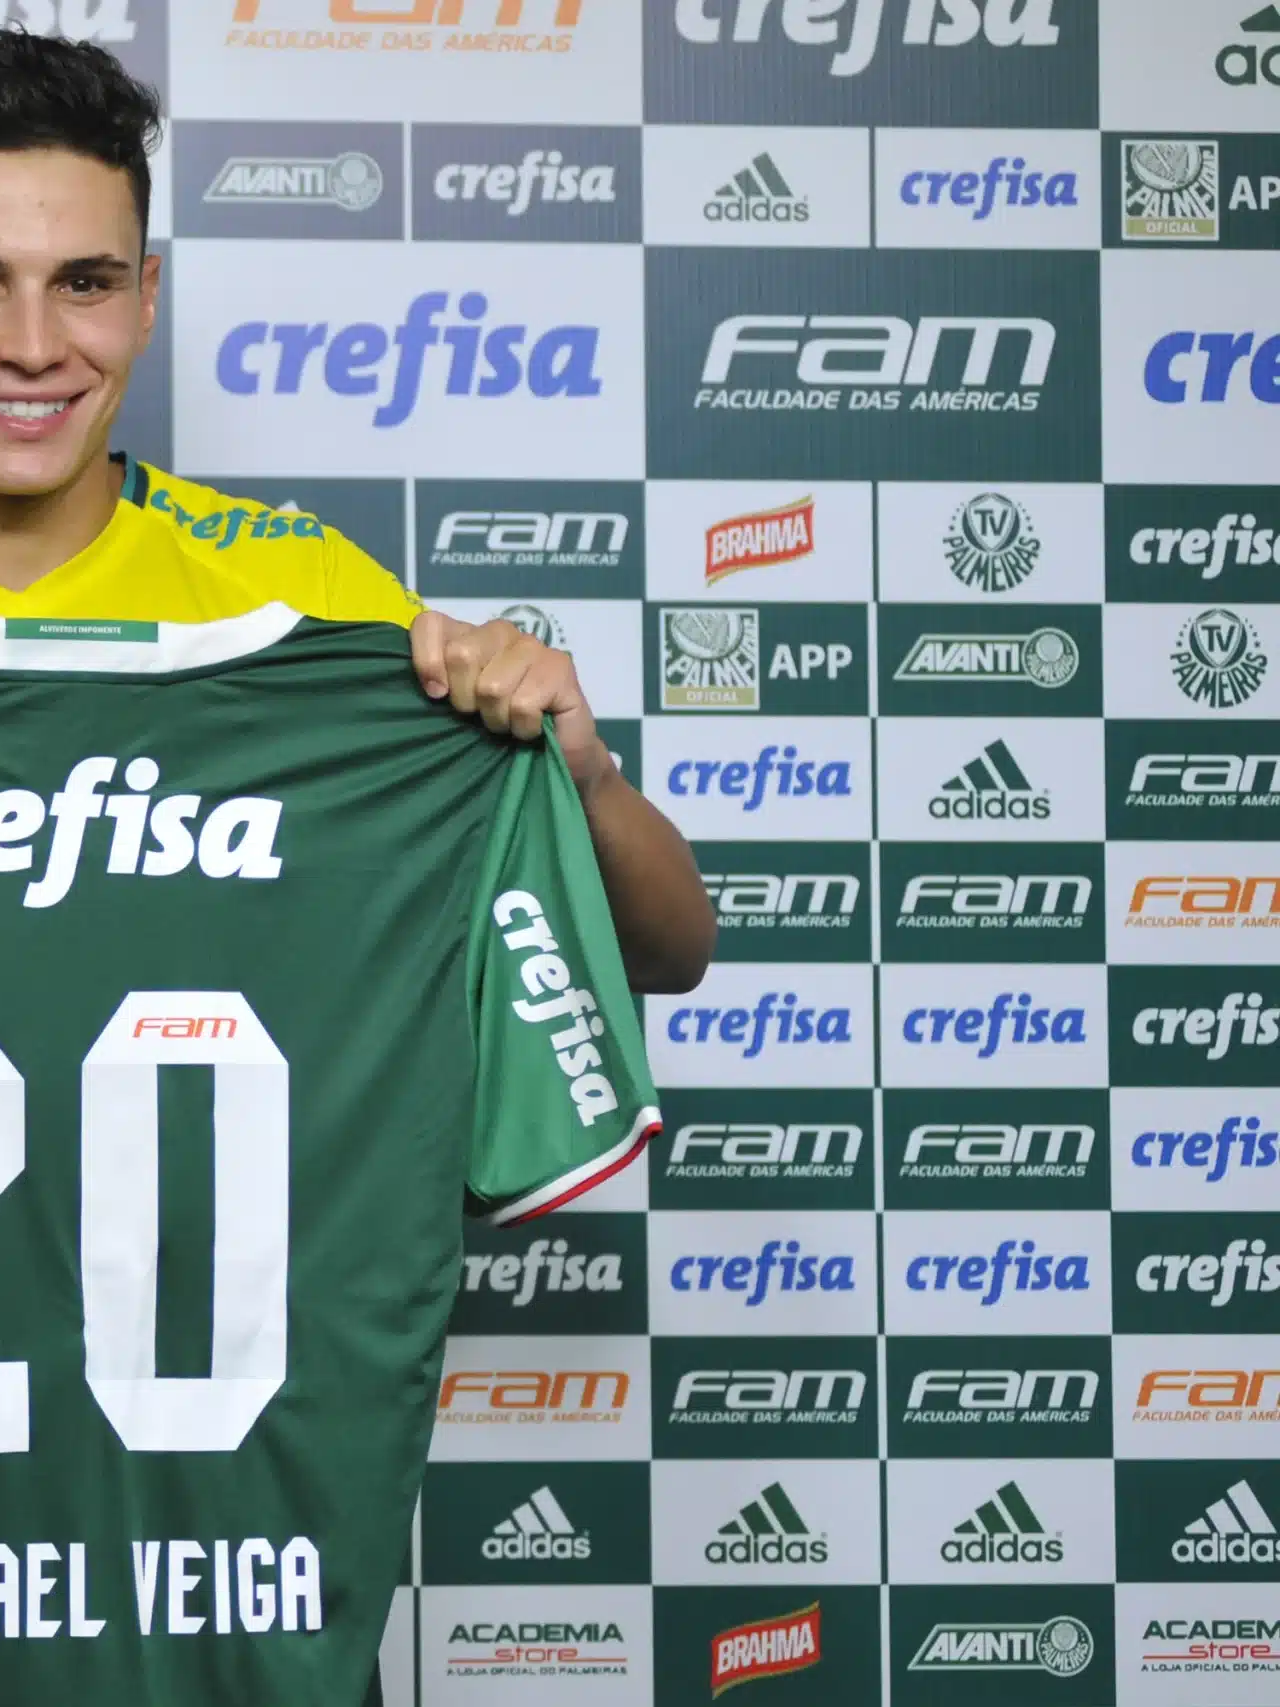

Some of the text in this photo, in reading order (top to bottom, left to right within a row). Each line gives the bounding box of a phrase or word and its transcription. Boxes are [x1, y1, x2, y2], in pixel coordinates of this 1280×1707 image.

[218, 166, 325, 193] AVANTI
[433, 150, 615, 215] crefisa
[900, 157, 1078, 220] crefisa
[703, 197, 809, 222] adidas
[216, 291, 602, 428] crefisa
[695, 389, 840, 412] FACULDADE
[850, 389, 900, 412] DAS
[150, 489, 325, 551] crefisa
[974, 508, 1009, 537] TV
[710, 513, 809, 566] BRAHMA
[1129, 513, 1280, 579] crefis
[943, 534, 1042, 593] PALMEIRAS
[1202, 624, 1236, 653] TV
[768, 644, 852, 680] APP
[908, 642, 1018, 672] AVANTI
[1170, 649, 1268, 709] PALMEIRAS
[668, 745, 851, 811] crefisa
[929, 788, 1051, 819] adidas
[897, 915, 974, 928] FACULDADE
[980, 915, 1008, 928] DAS
[492, 889, 619, 1128] crefisa
[668, 992, 851, 1059] crefisa
[902, 992, 1087, 1059] crefisa
[666, 1165, 746, 1178] FACULDADE
[750, 1165, 778, 1178] DAS
[900, 1165, 979, 1177] FACULDADE
[983, 1165, 1011, 1177] DAS
[461, 1239, 623, 1307] refisa
[670, 1240, 855, 1306] crefisa
[906, 1240, 1089, 1306] crefisa
[669, 1411, 747, 1424] FACULDADE
[753, 1411, 781, 1424] DAS
[903, 1411, 982, 1423] FACULDADE
[987, 1411, 1015, 1423] DAS
[481, 1532, 592, 1560] adidas
[704, 1532, 828, 1564] adidas
[940, 1531, 1064, 1563] adidas
[131, 1536, 322, 1636] VEIGA
[448, 1623, 624, 1644] ACADEMIA
[715, 1620, 815, 1676] BRAHMA
[924, 1632, 1033, 1662] AVANTI
[495, 1647, 578, 1663] store
[1189, 1641, 1272, 1659] store
[1152, 1664, 1182, 1672] LOJA
[1185, 1664, 1230, 1672] OFICIAL
